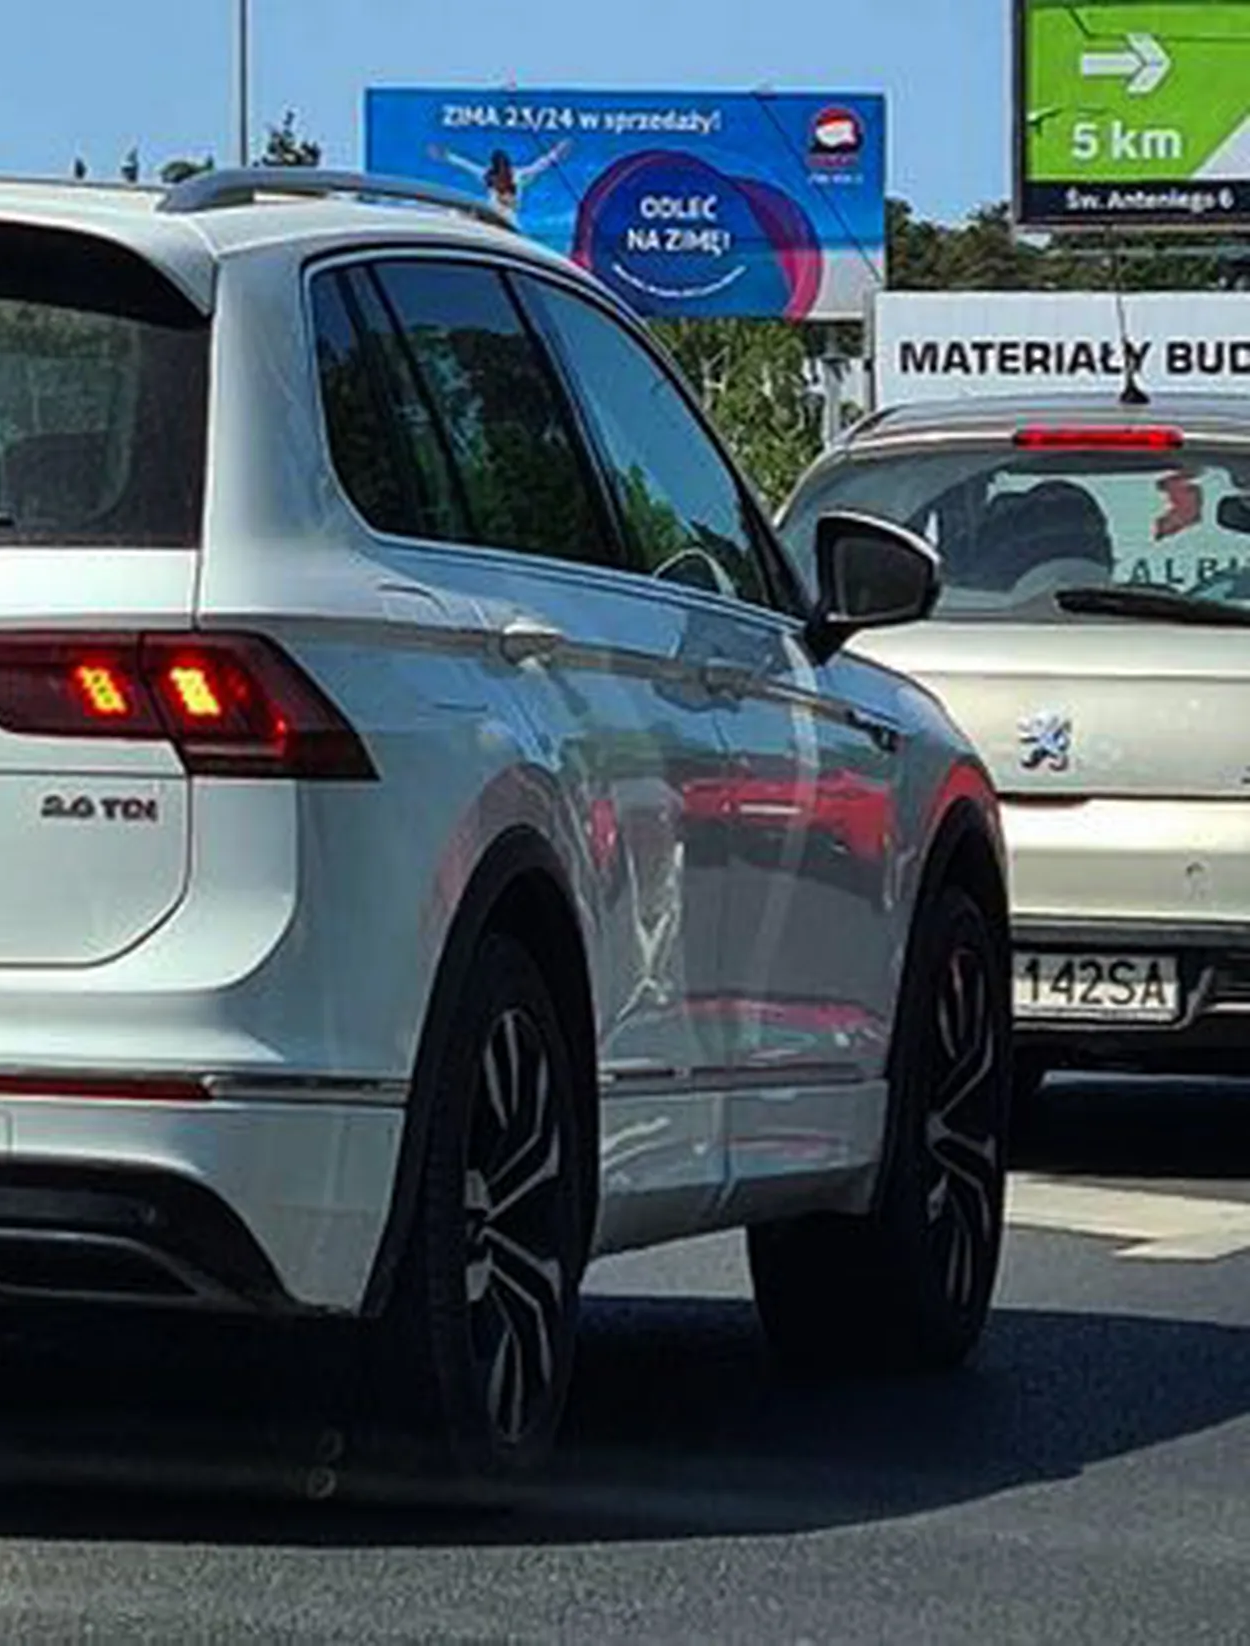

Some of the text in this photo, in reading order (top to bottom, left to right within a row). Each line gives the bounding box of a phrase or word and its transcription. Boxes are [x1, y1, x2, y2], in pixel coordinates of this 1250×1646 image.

[442, 104, 500, 127] ZIMA
[505, 106, 574, 132] 23/24
[578, 112, 599, 130] w
[1071, 119, 1182, 160] 5 km
[640, 194, 718, 219] ODLEĆ
[627, 228, 660, 250] NA
[899, 341, 1152, 375] MATERIAŁY
[100, 797, 158, 822] TDI
[1024, 957, 1167, 1005] 142SA
